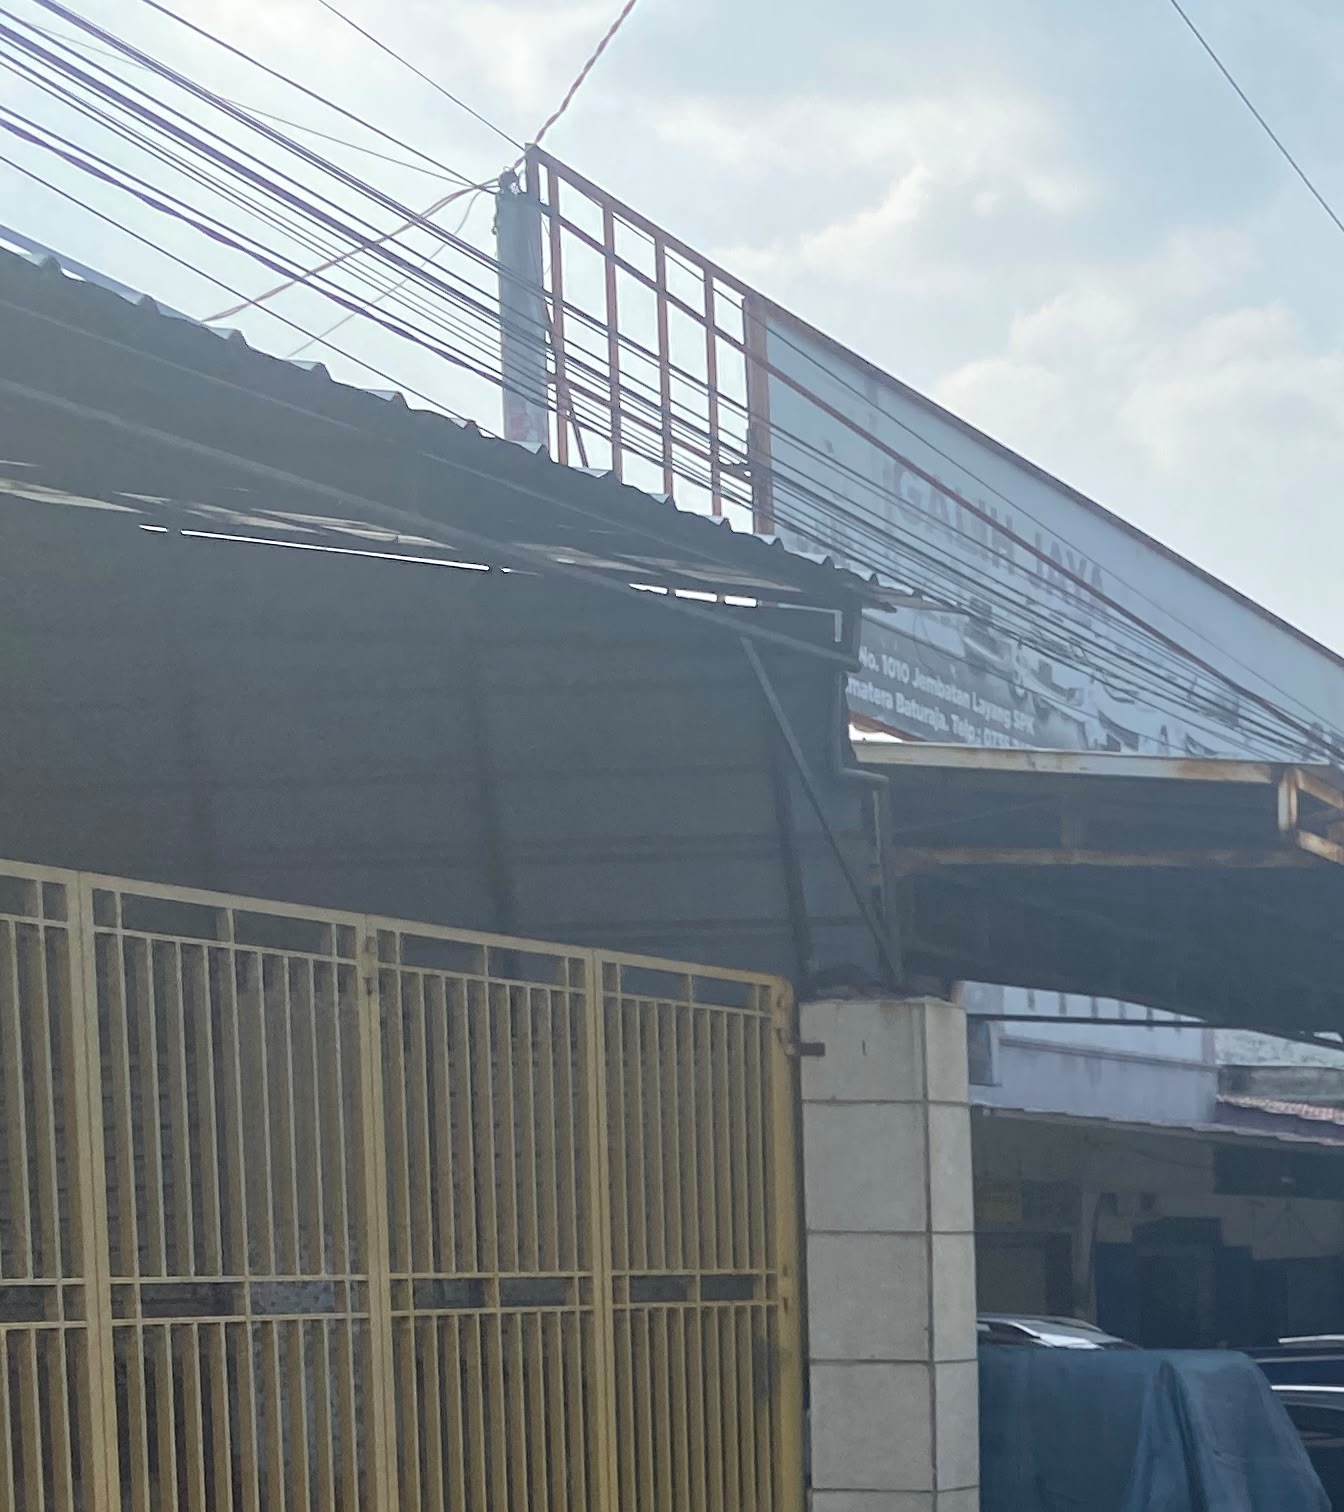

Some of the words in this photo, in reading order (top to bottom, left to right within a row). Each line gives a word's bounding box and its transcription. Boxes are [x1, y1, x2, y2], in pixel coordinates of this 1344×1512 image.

[846, 677, 893, 709] matera
[859, 646, 880, 673] No.
[882, 654, 910, 684] 1010
[912, 668, 971, 709] Jembatan
[972, 692, 1011, 729] Layang
